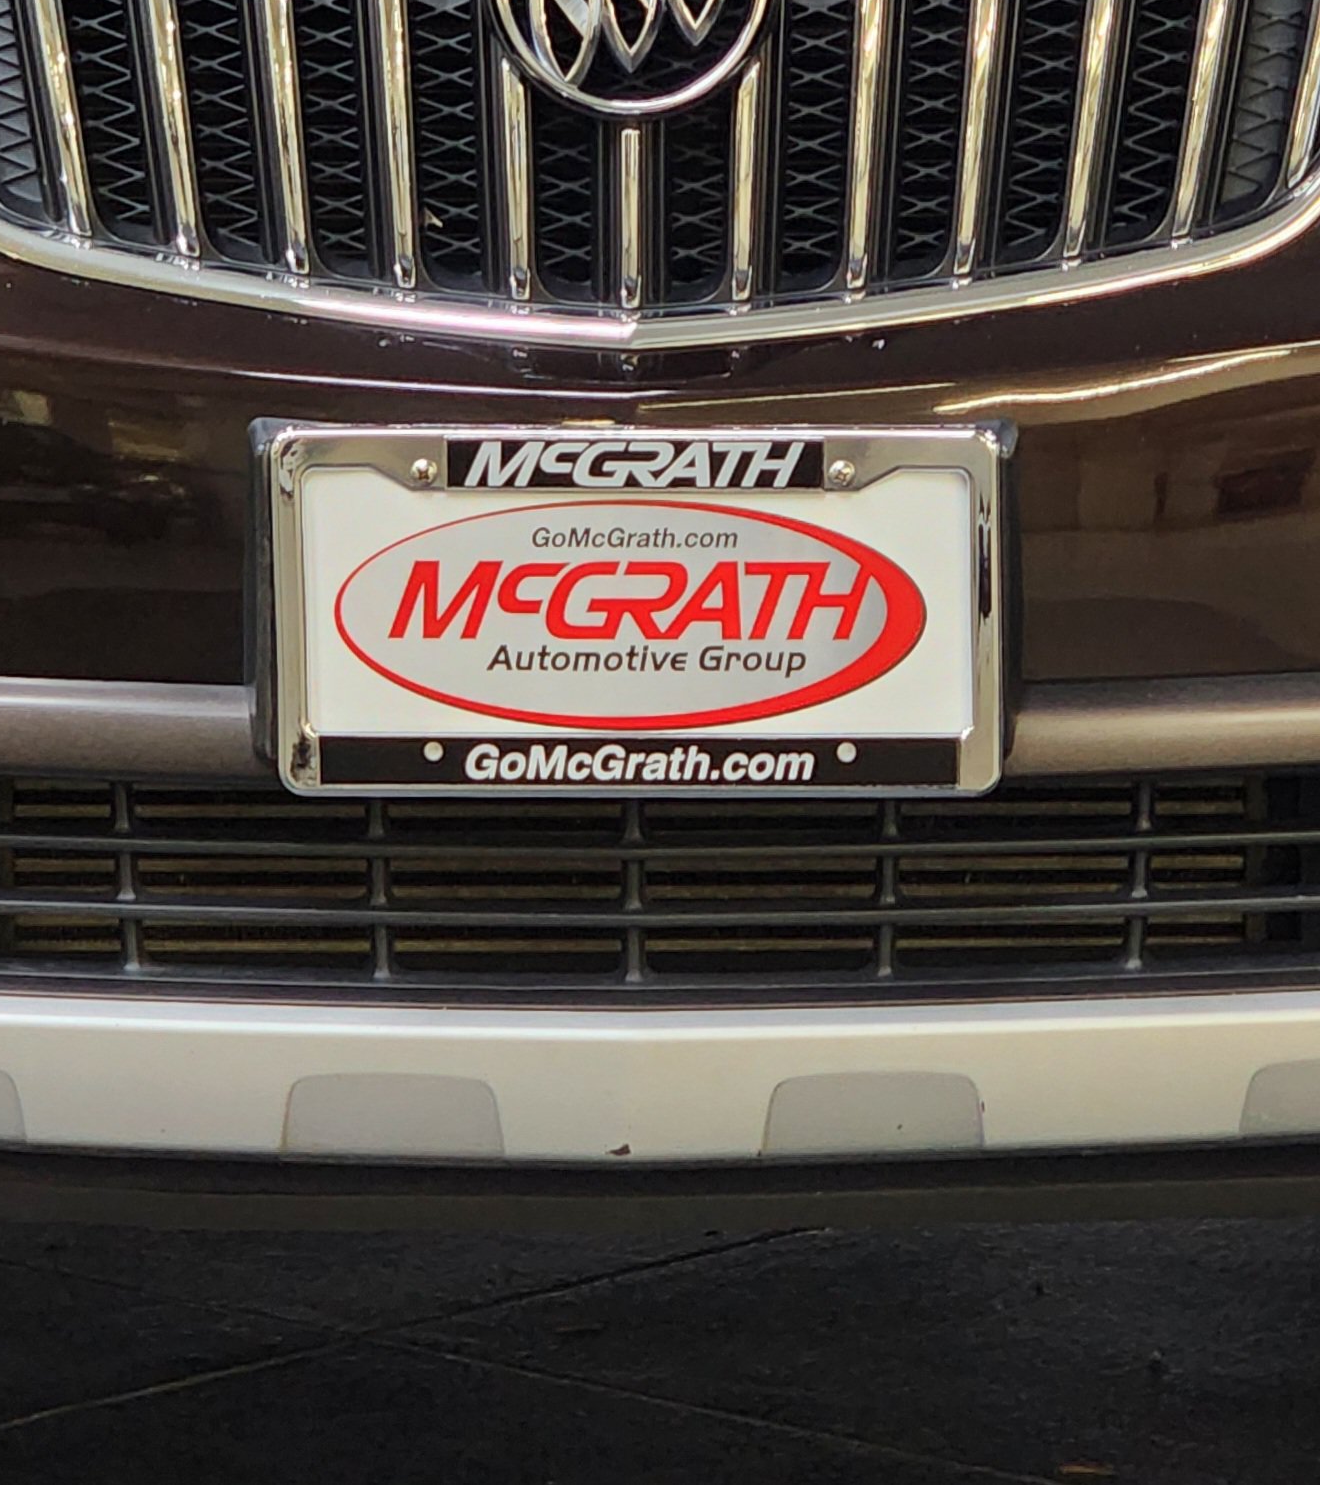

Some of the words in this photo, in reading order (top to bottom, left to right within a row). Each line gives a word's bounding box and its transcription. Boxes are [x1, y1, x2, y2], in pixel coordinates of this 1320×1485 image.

[531, 526, 738, 549] GoMcGrath.com
[486, 644, 688, 672] Automotive
[700, 646, 806, 678] Group
[464, 743, 815, 782] GoMcGrath.com
